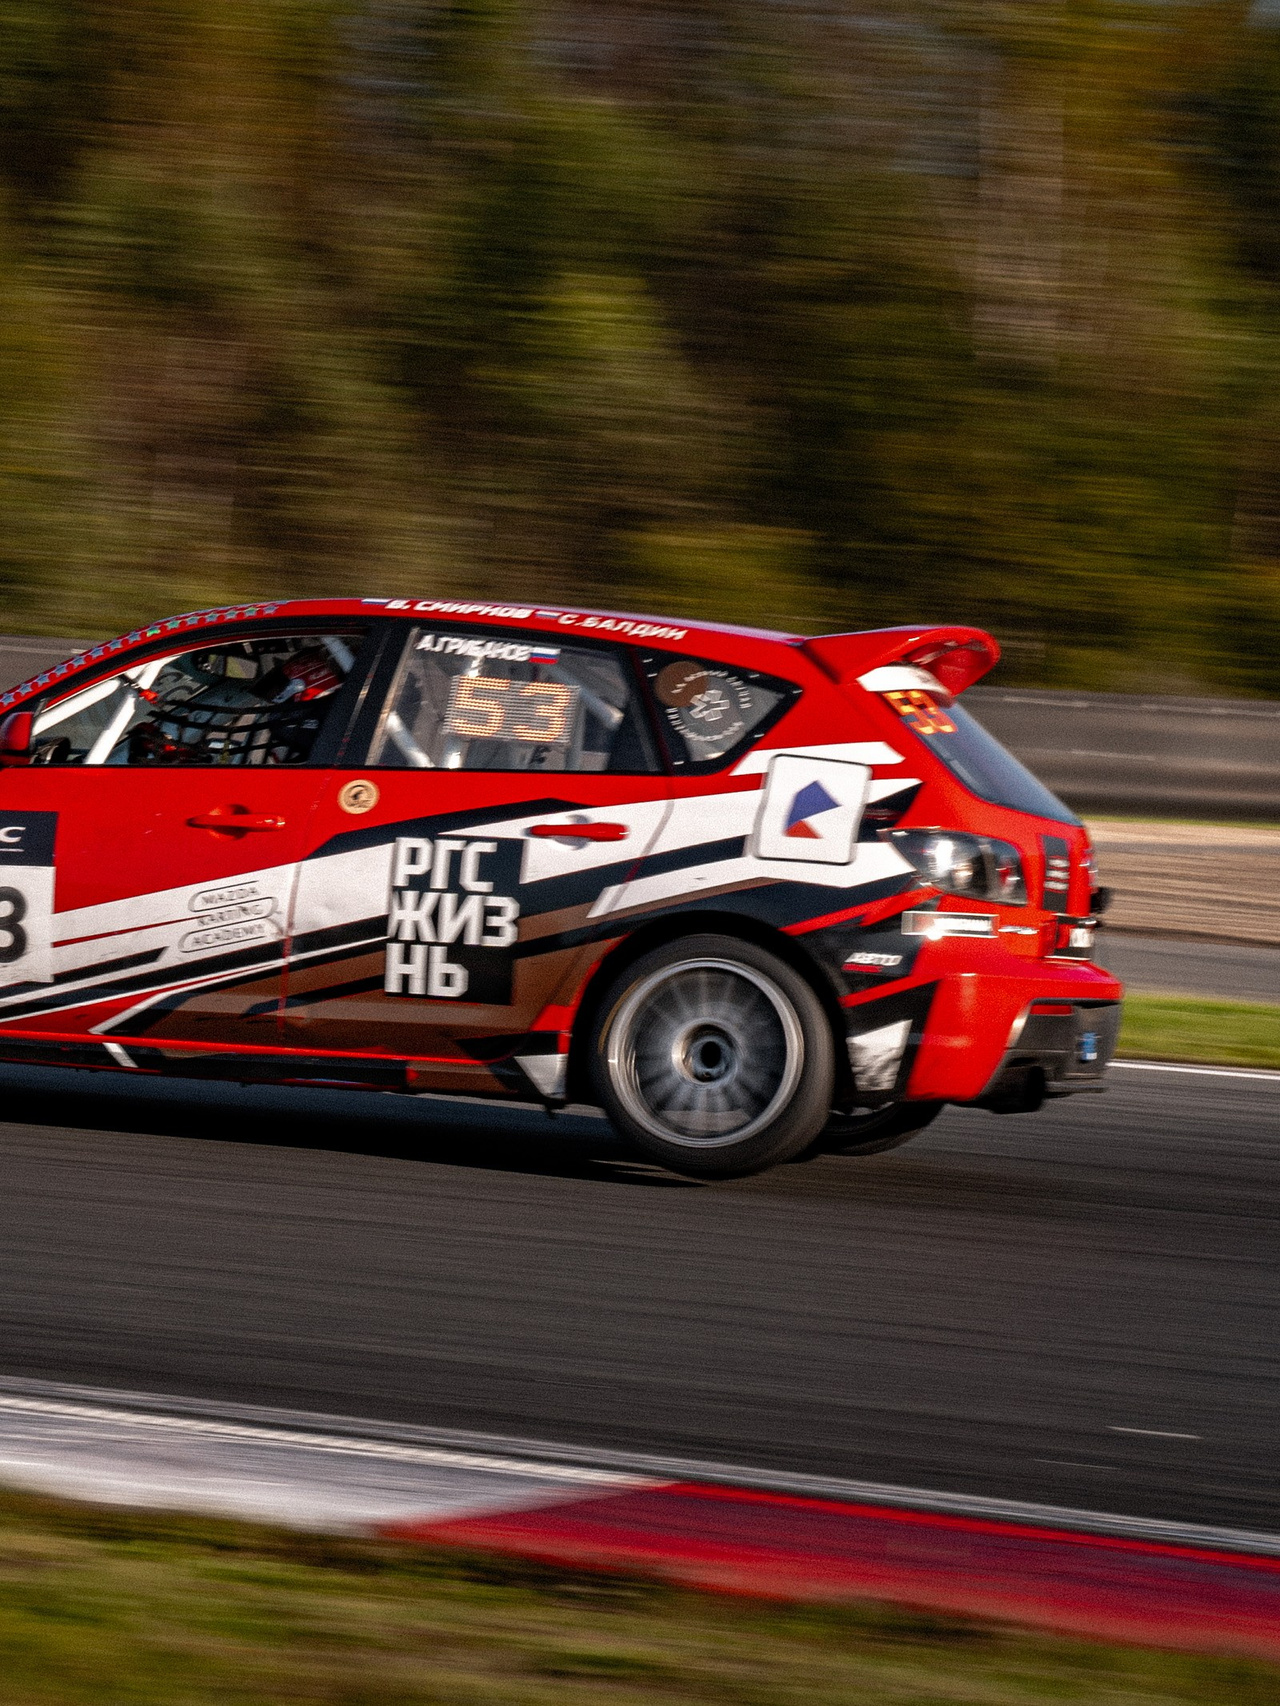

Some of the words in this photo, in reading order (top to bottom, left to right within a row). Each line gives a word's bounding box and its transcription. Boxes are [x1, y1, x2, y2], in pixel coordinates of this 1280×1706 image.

[413, 601, 535, 620] СМИРНОВ
[451, 676, 572, 743] 53
[391, 836, 498, 893] РГС
[202, 887, 259, 904] MAZDA
[386, 890, 521, 948] ЖИЗ
[191, 922, 266, 946] ACADEMY
[383, 942, 470, 998] НЬ
